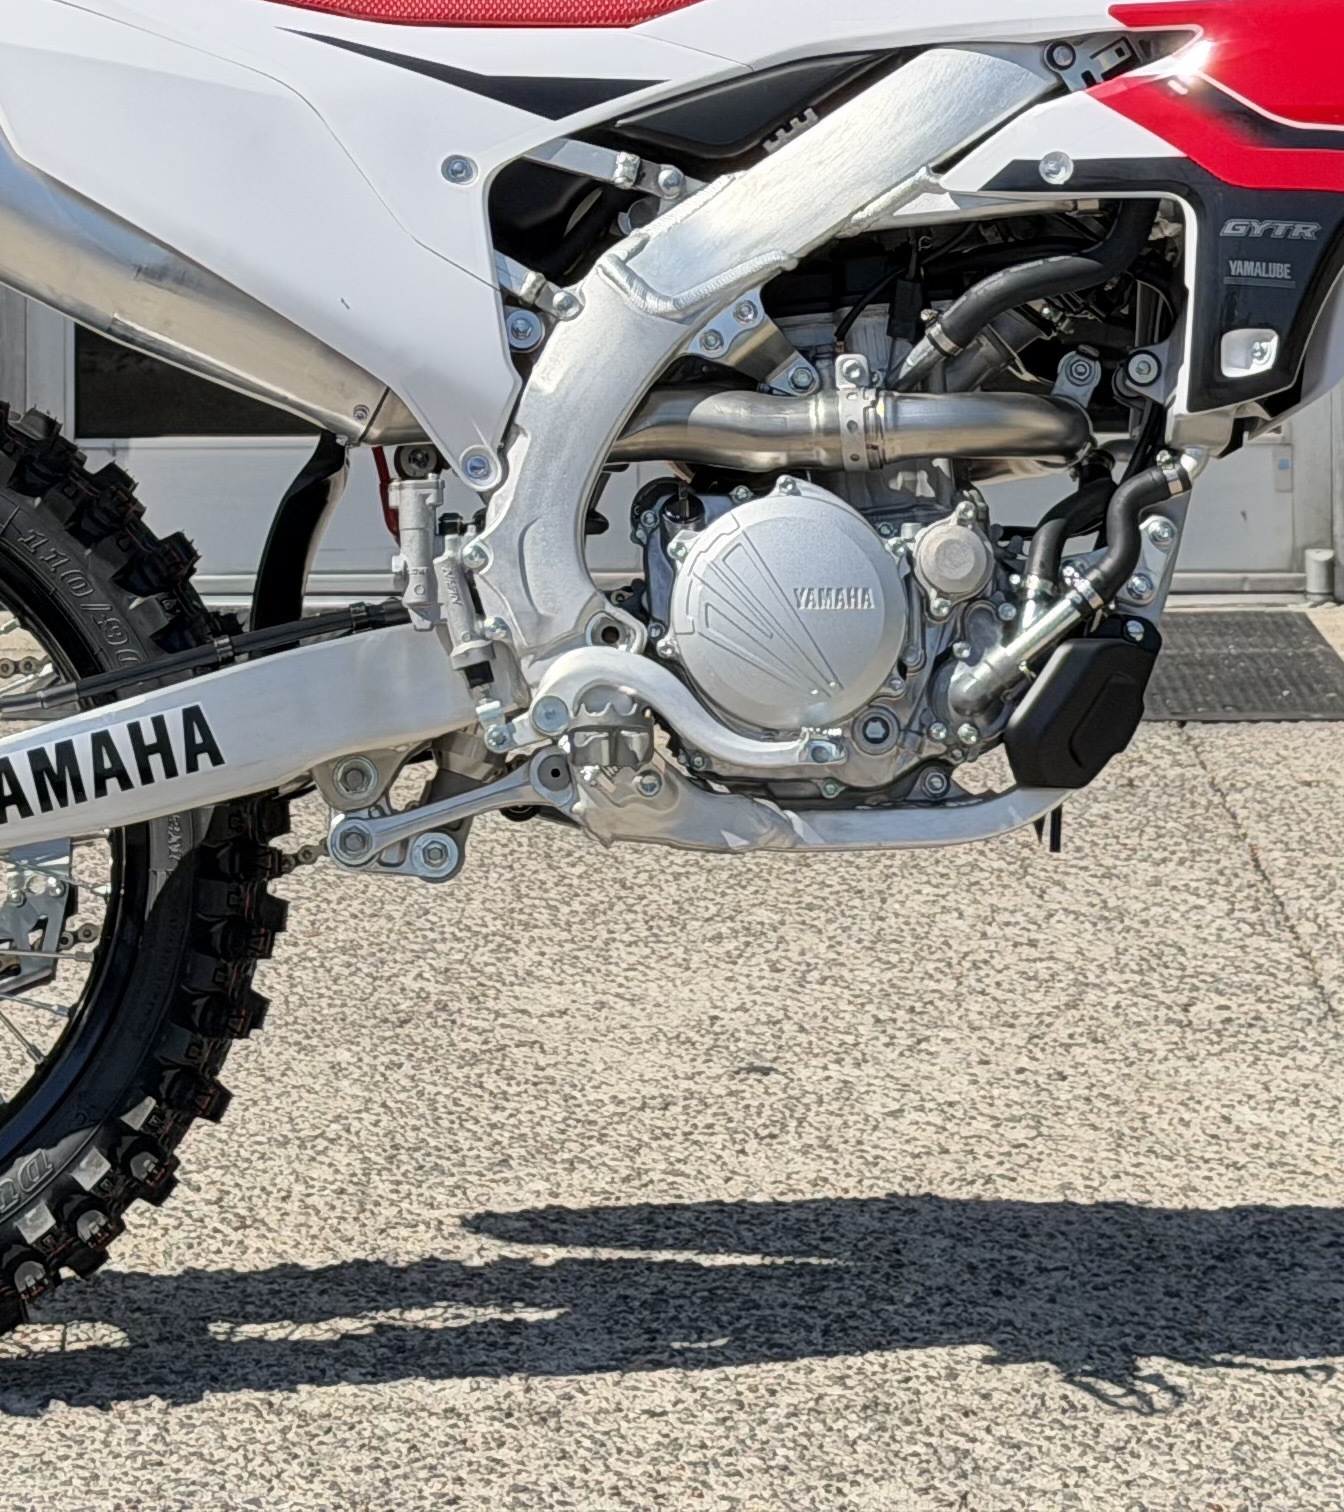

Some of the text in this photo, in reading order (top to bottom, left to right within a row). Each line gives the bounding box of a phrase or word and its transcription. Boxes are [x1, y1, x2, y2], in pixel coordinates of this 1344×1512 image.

[1219, 218, 1322, 240] GYTR
[1228, 259, 1292, 280] YAMALUBE
[792, 586, 876, 610] YAMAHA
